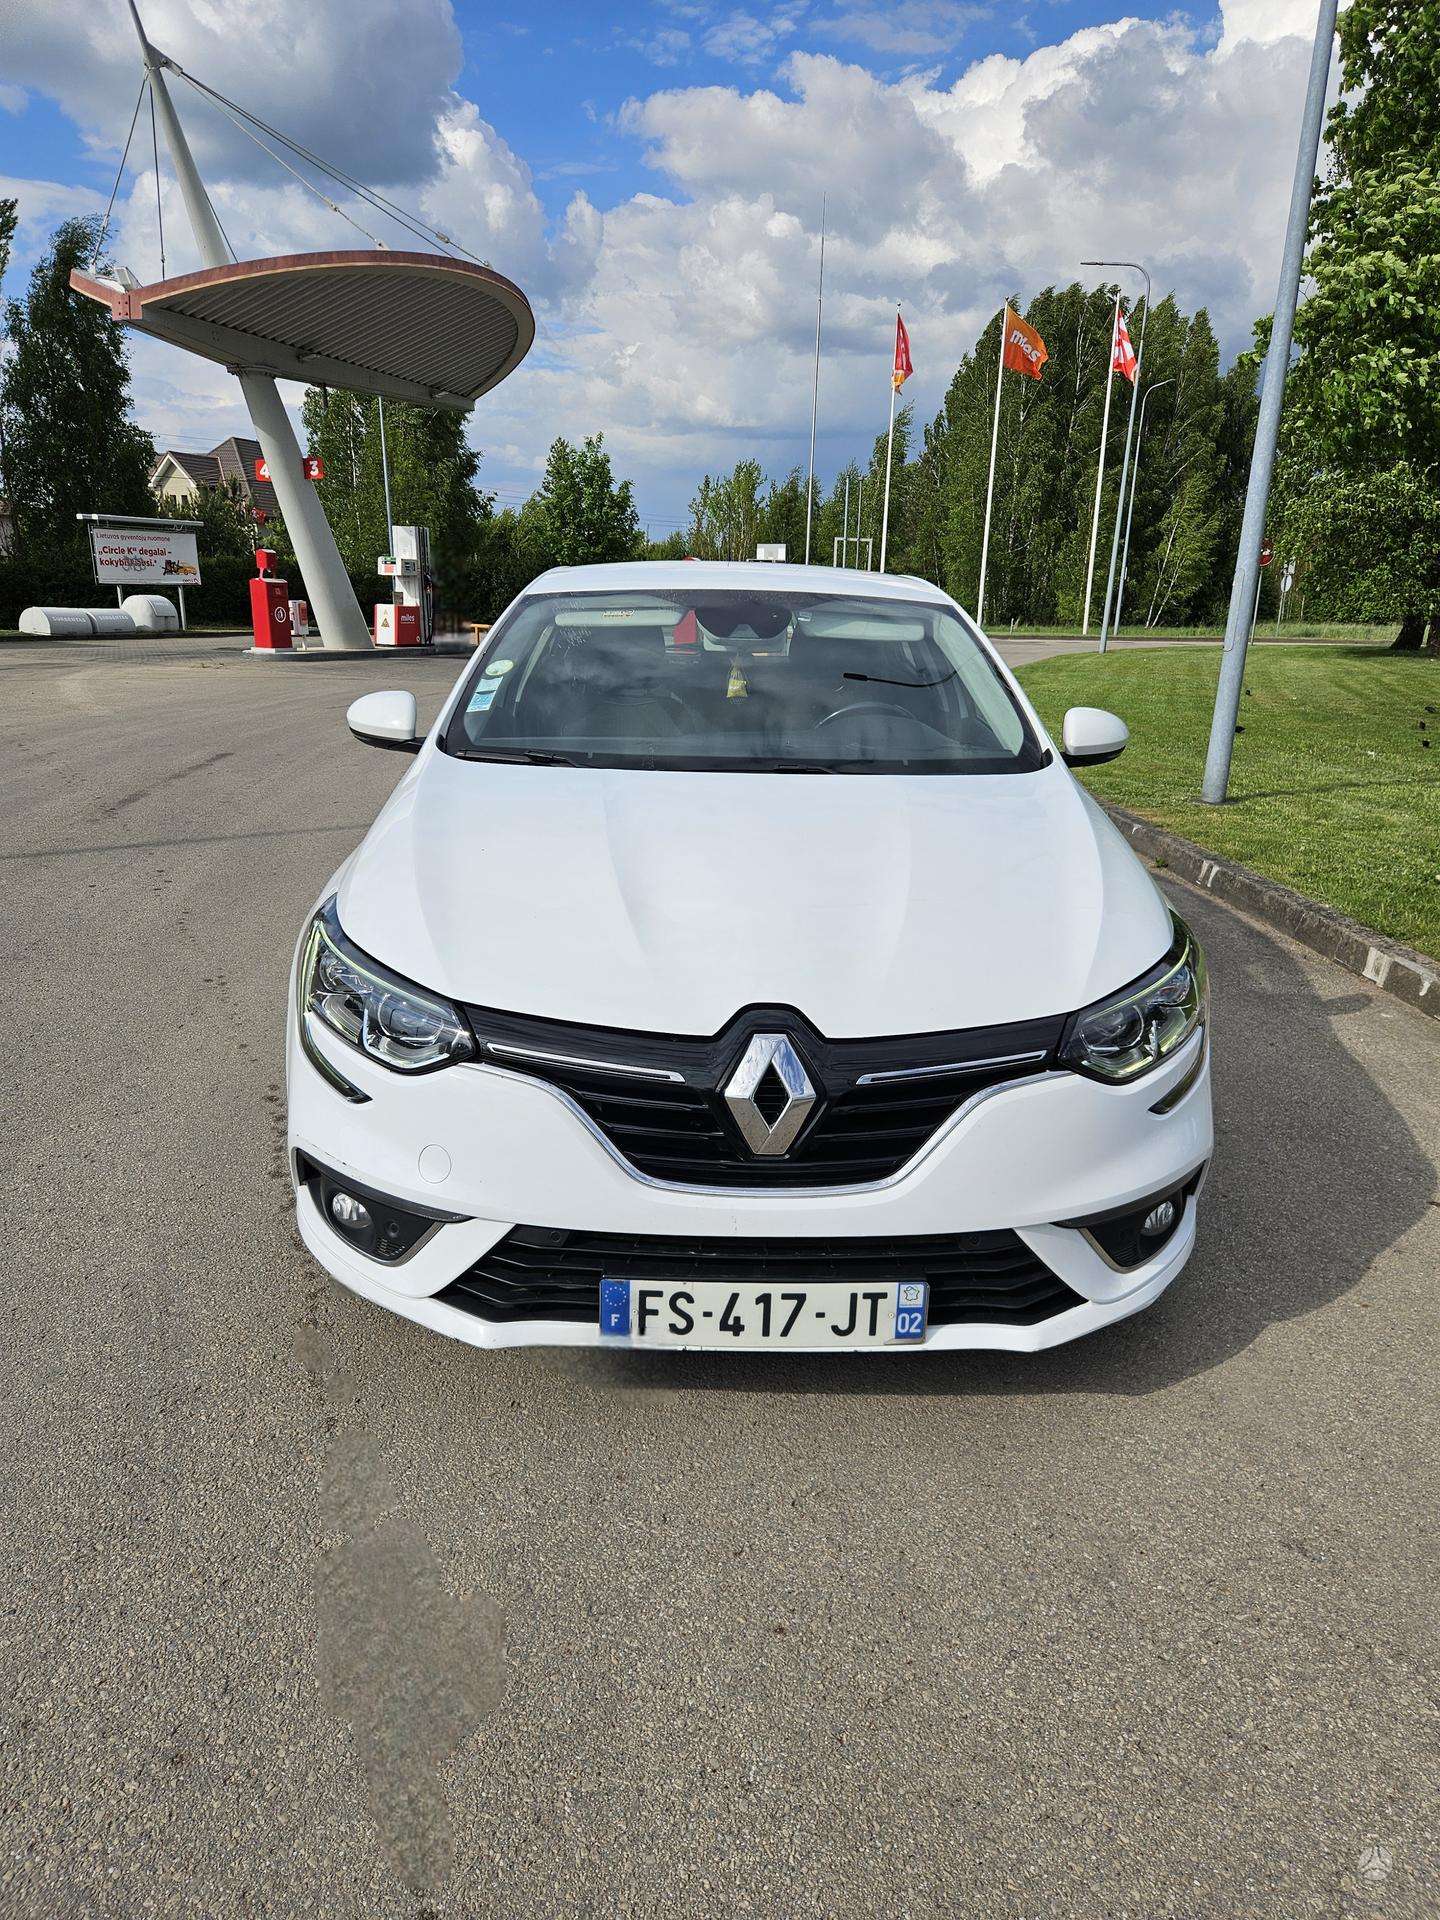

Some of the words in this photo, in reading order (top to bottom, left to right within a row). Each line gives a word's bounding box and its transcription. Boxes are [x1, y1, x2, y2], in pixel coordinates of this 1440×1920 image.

[260, 463, 270, 478] 4
[310, 460, 319, 476] 3
[139, 547, 167, 557] degalai
[610, 1314, 620, 1326] F
[638, 1290, 888, 1337] FS-417-JT
[897, 1313, 921, 1333] 02
